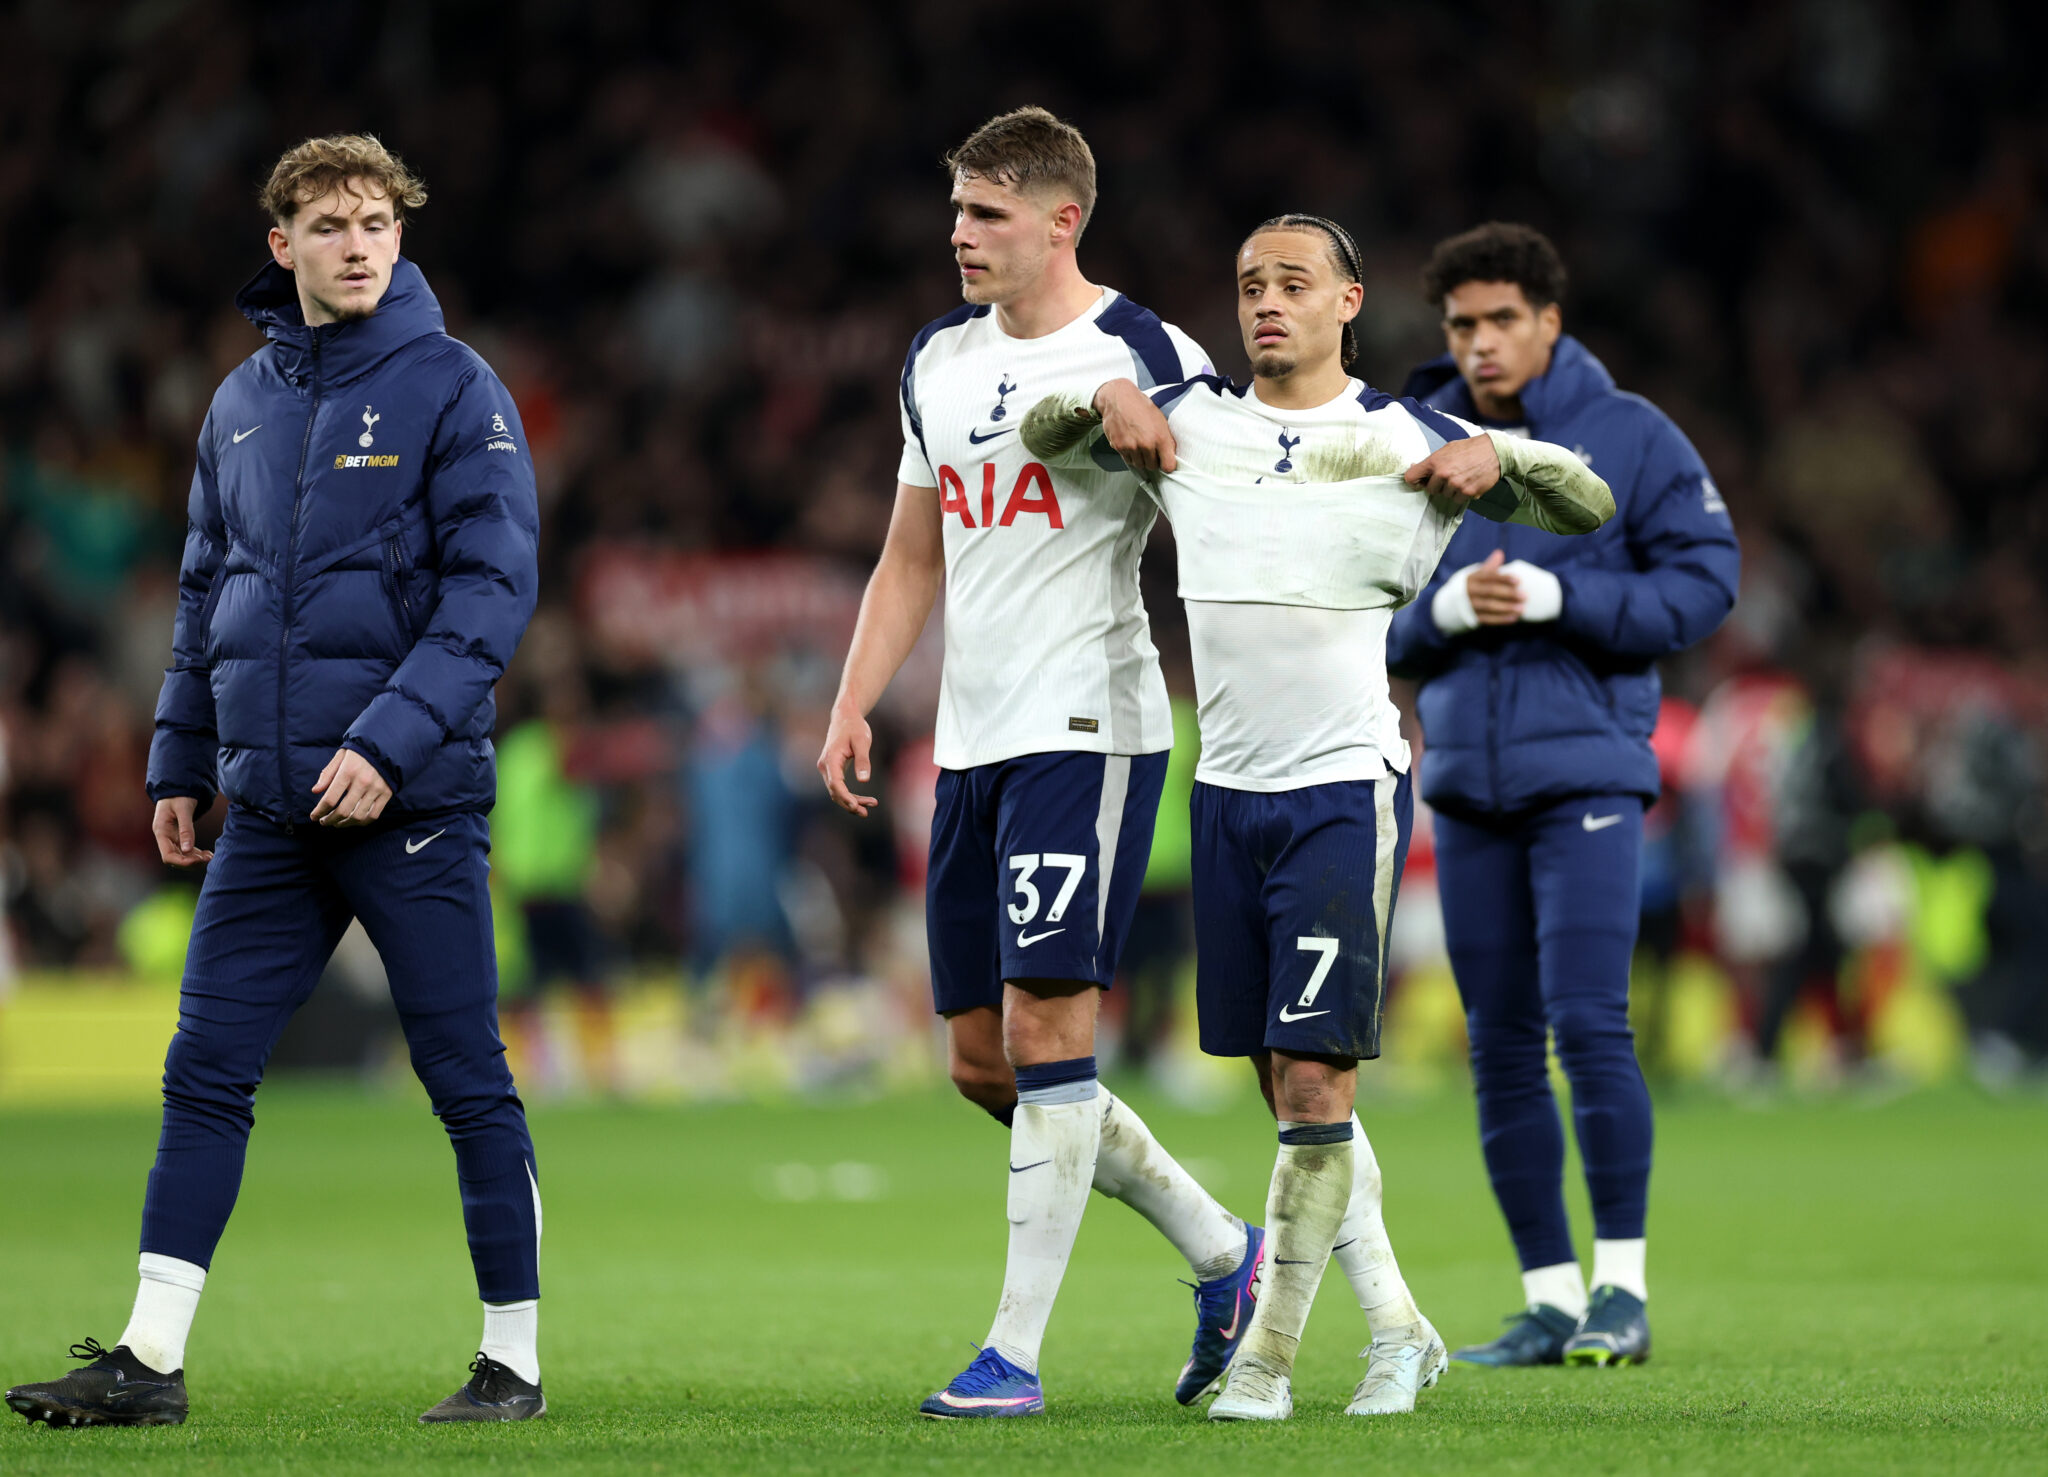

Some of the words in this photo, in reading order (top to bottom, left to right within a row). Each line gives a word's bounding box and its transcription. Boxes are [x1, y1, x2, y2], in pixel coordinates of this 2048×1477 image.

[345, 455, 399, 468] BETMGM
[939, 462, 1064, 529] AIA
[1007, 853, 1087, 925] 37
[1297, 936, 1339, 1007] 7
